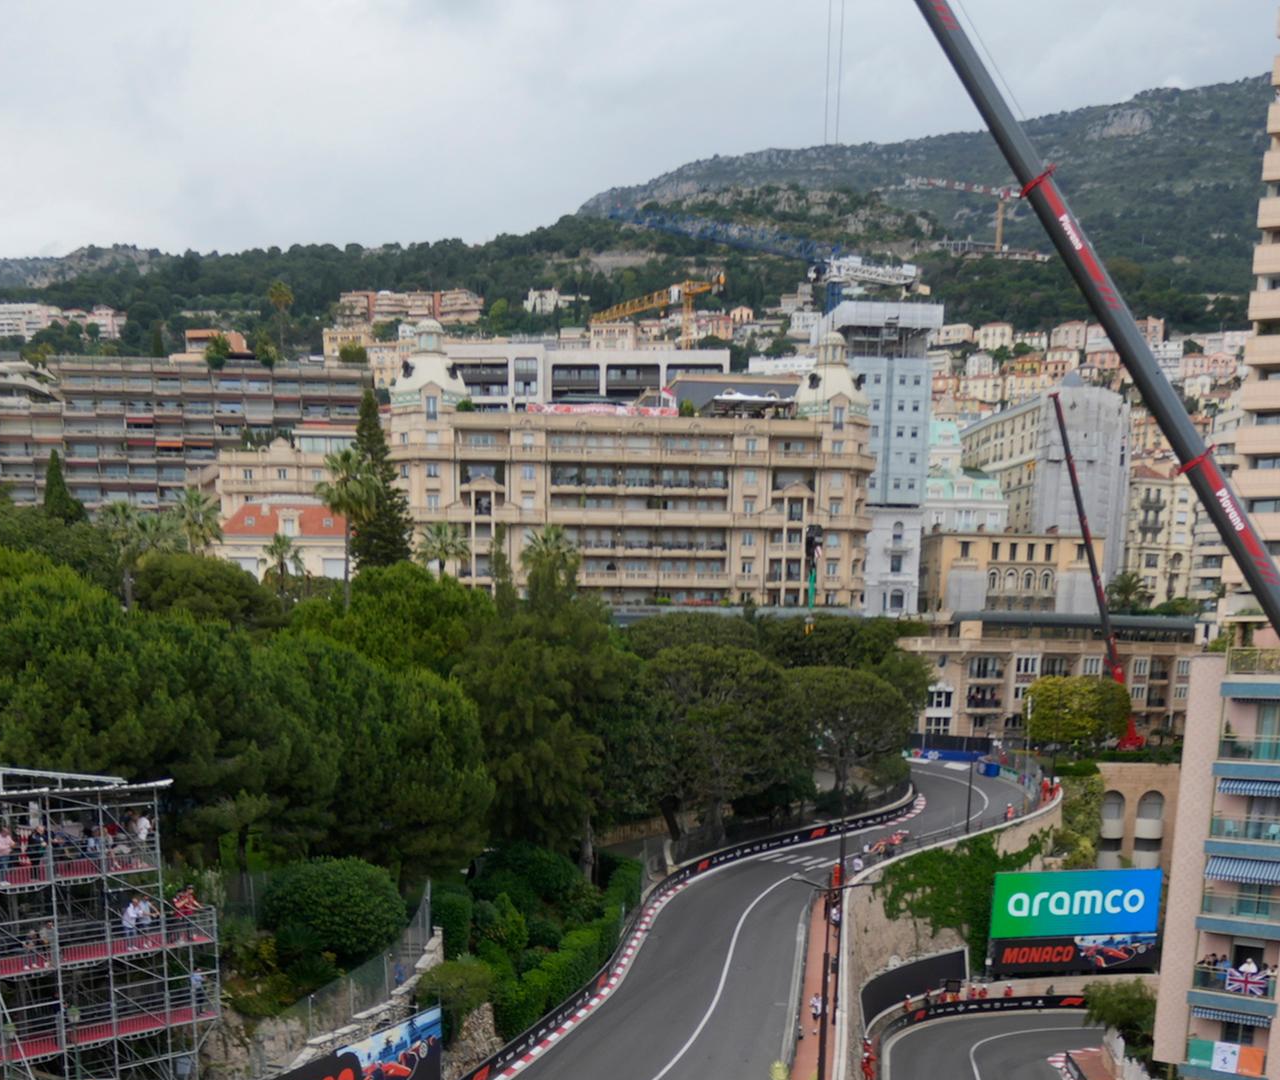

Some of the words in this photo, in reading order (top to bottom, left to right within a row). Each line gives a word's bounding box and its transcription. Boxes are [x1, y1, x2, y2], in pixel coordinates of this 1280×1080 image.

[1216, 488, 1245, 531] Piovano
[1008, 889, 1145, 917] aramco
[1002, 945, 1075, 964] MONACO
